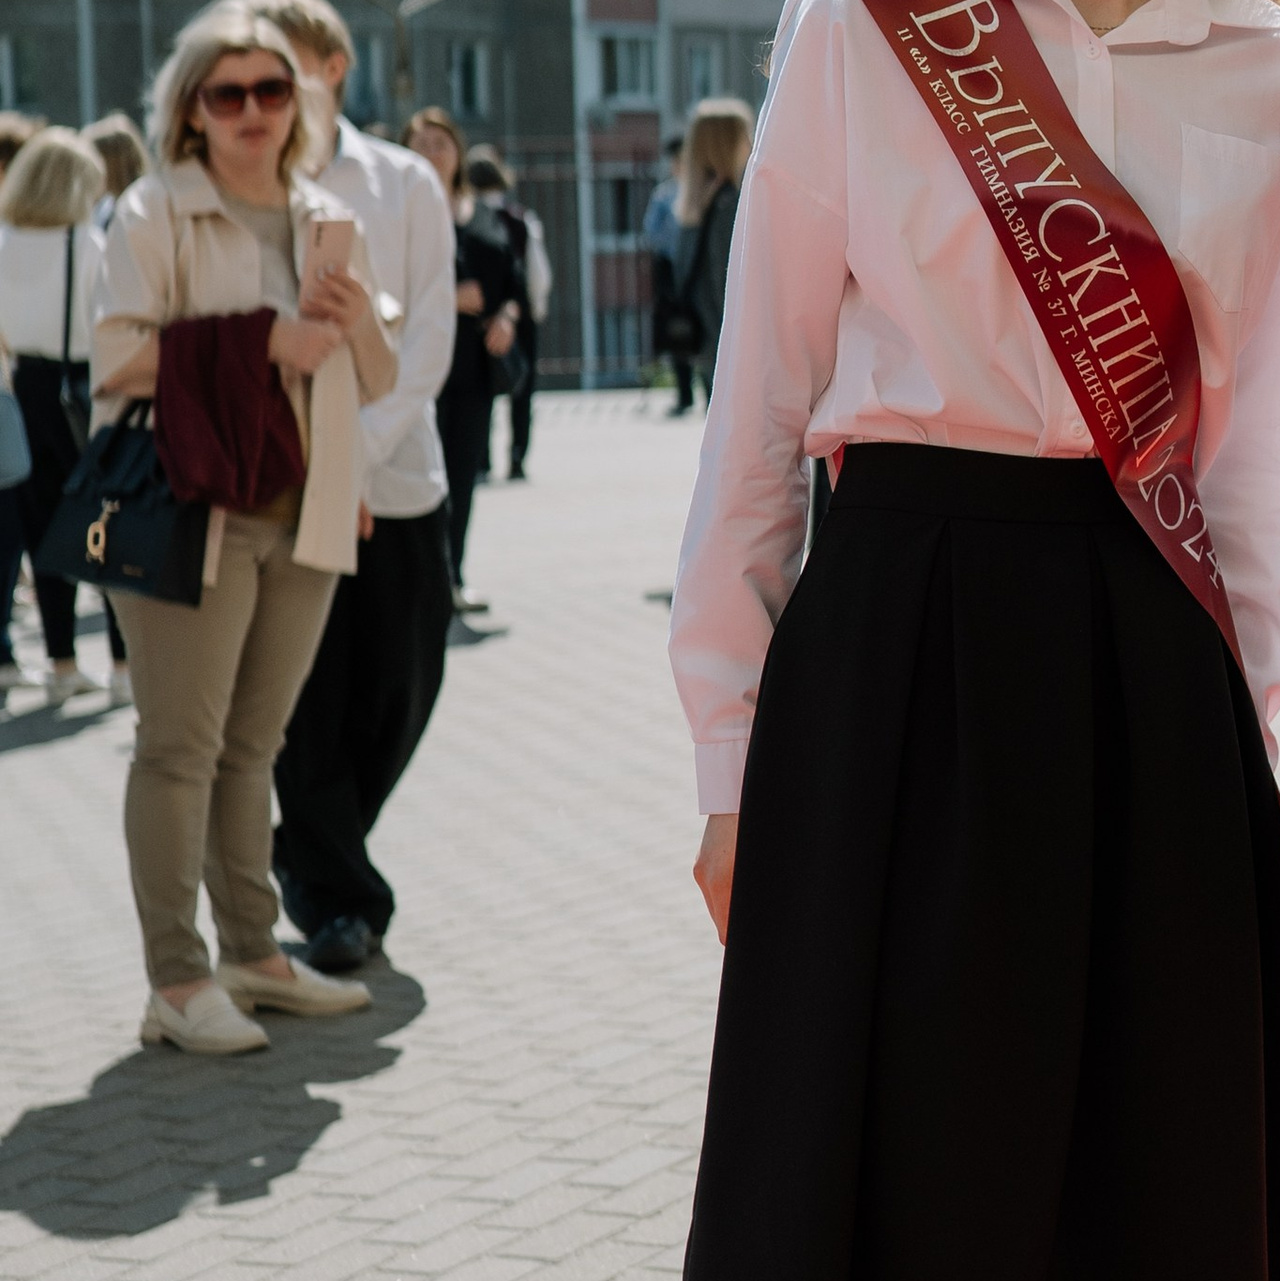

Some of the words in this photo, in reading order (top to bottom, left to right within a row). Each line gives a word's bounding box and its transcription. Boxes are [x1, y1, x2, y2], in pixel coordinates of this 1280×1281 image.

[896, 27, 913, 42] 11
[929, 78, 971, 135] КЛАСС
[970, 144, 1041, 263] ГИМНАЗИЯ
[1047, 298, 1067, 317] 37
[1060, 324, 1078, 345] Г.
[1071, 348, 1121, 440] МИНСКА
